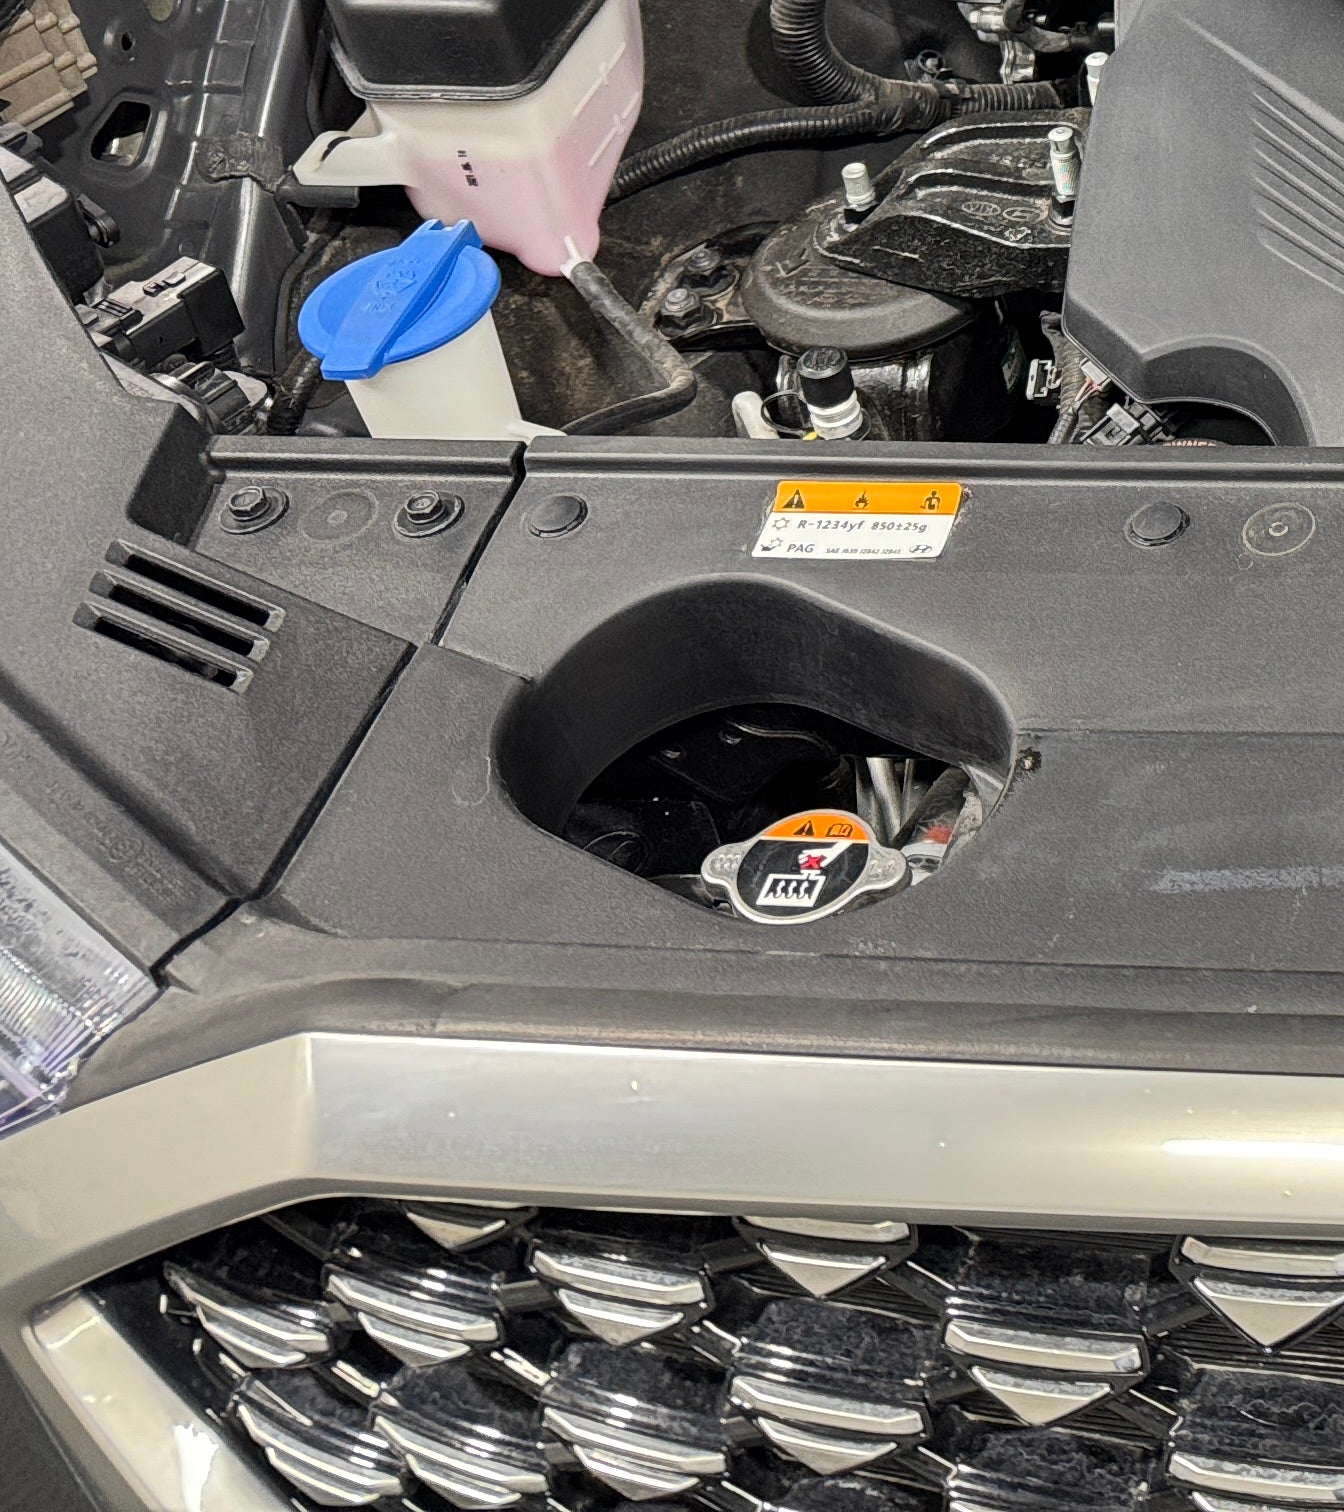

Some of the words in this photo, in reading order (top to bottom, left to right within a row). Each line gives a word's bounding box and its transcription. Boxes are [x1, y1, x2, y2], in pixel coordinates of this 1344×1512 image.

[796, 518, 866, 536] R-1234yf
[870, 520, 928, 535] 850±25g
[786, 543, 816, 554] PAG
